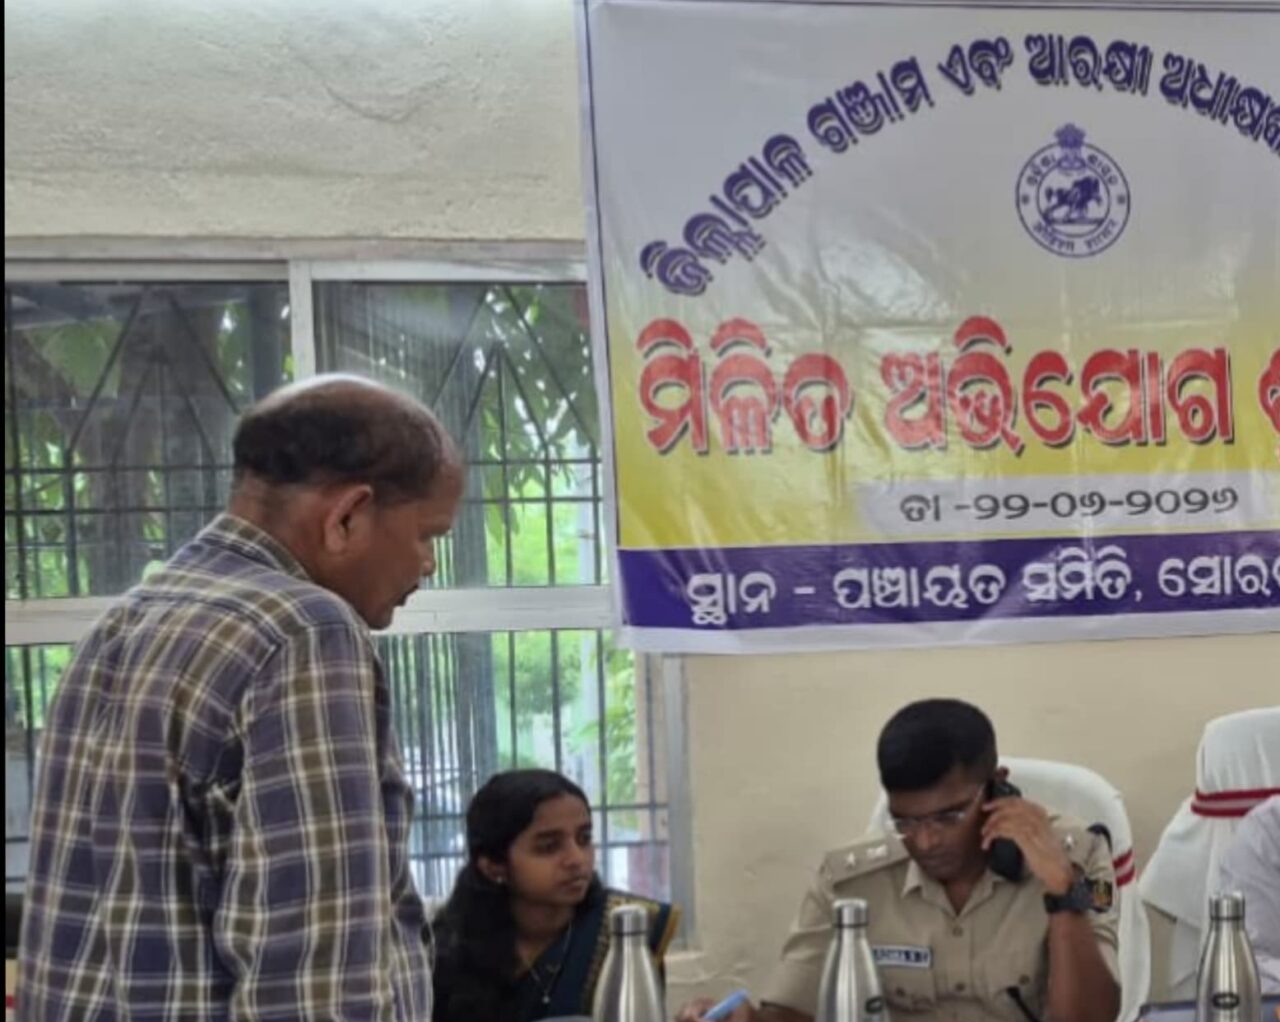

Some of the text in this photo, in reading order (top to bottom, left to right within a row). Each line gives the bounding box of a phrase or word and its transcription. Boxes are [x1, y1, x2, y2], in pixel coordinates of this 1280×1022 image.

[807, 56, 935, 152] ଗଞ୍ଜାମ
[937, 36, 1013, 96] ଏବଂ
[637, 318, 851, 455] ମିଳିତ
[881, 316, 1234, 457] ଅଭିଯୋଗ
[686, 571, 776, 625] ସ୍ଥାନ
[833, 564, 1006, 609] ପଞ୍ଚାୟତ
